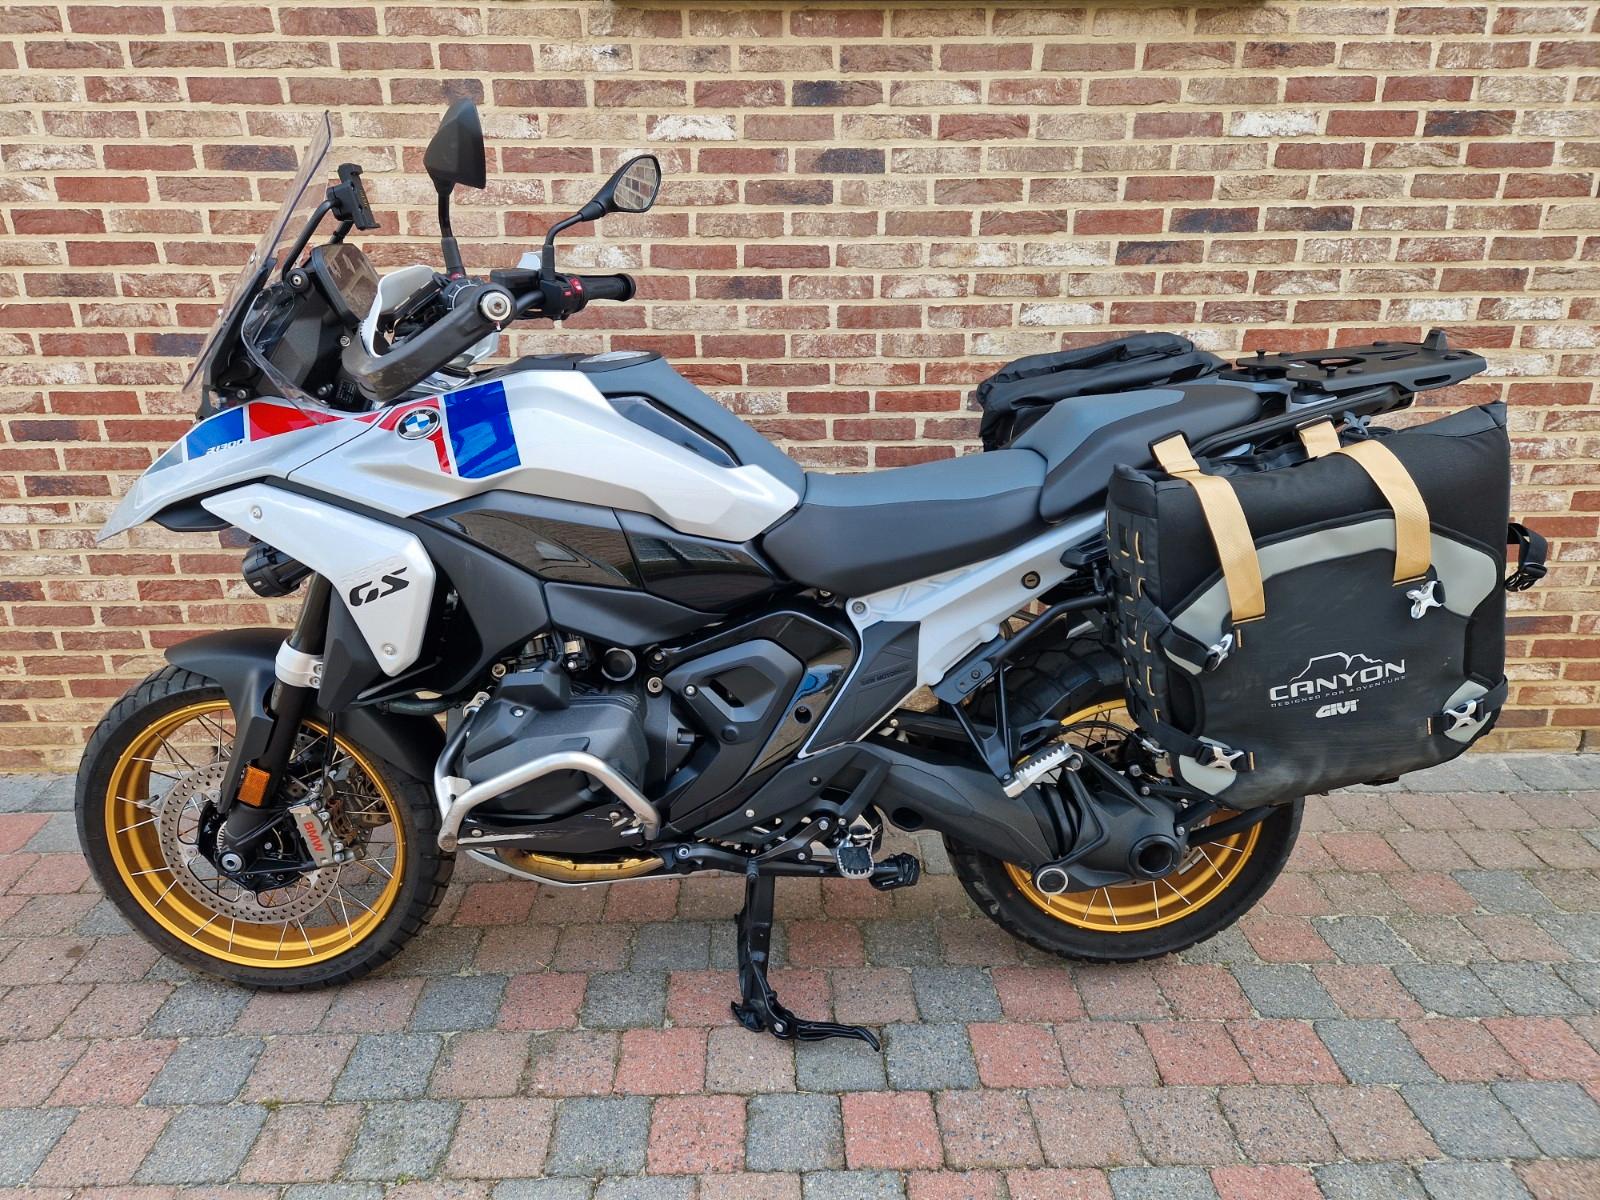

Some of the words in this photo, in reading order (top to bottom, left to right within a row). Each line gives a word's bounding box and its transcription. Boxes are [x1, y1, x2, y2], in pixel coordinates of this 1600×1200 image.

[349, 566, 410, 607] GS
[1269, 659, 1406, 701] CANYON
[1271, 694, 1321, 708] DESIGNED
[1325, 689, 1345, 698] FOR
[1348, 675, 1406, 693] ADVENTURE
[1315, 699, 1358, 719] GIVI
[303, 821, 326, 852] BMW
